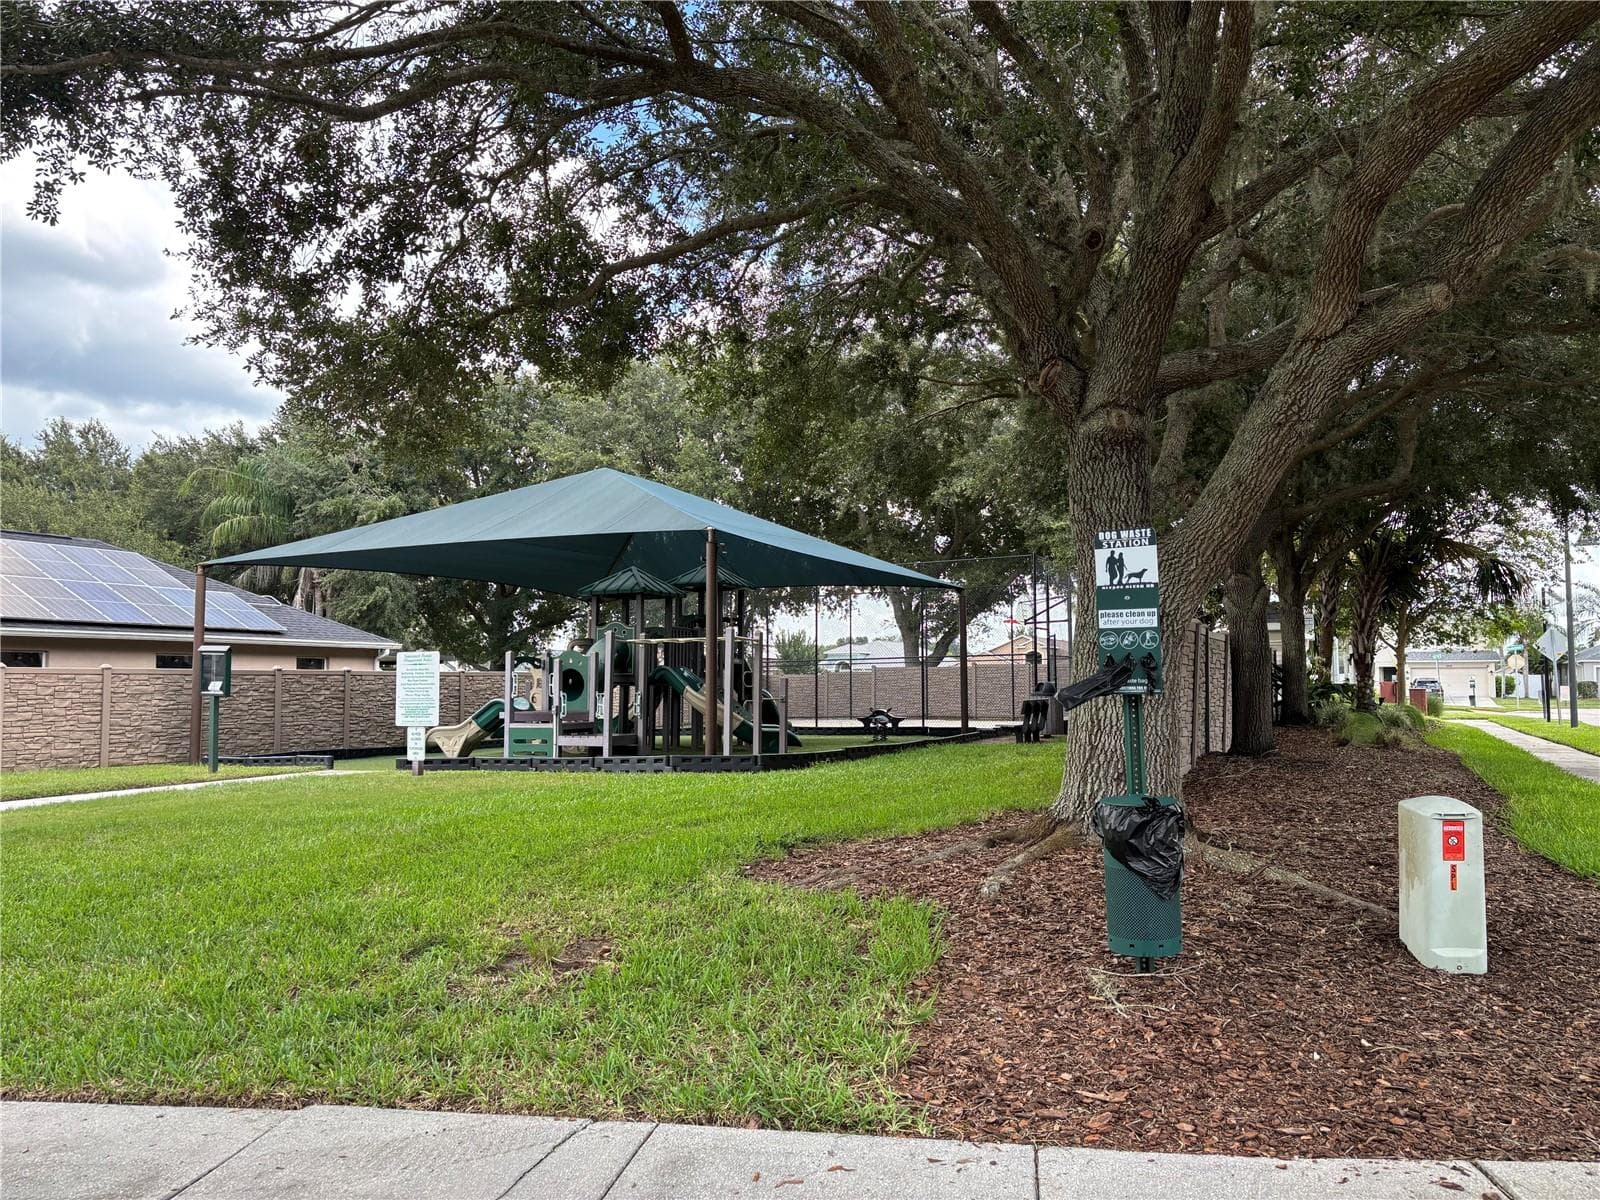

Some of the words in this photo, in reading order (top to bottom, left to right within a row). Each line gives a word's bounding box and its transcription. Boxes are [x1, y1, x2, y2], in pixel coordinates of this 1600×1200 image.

[1098, 531, 1117, 540] DOG
[1120, 528, 1152, 538] WASTE
[1102, 539, 1149, 549] STATION
[1100, 611, 1124, 619] please
[1147, 610, 1156, 618] up
[1121, 618, 1138, 626] your
